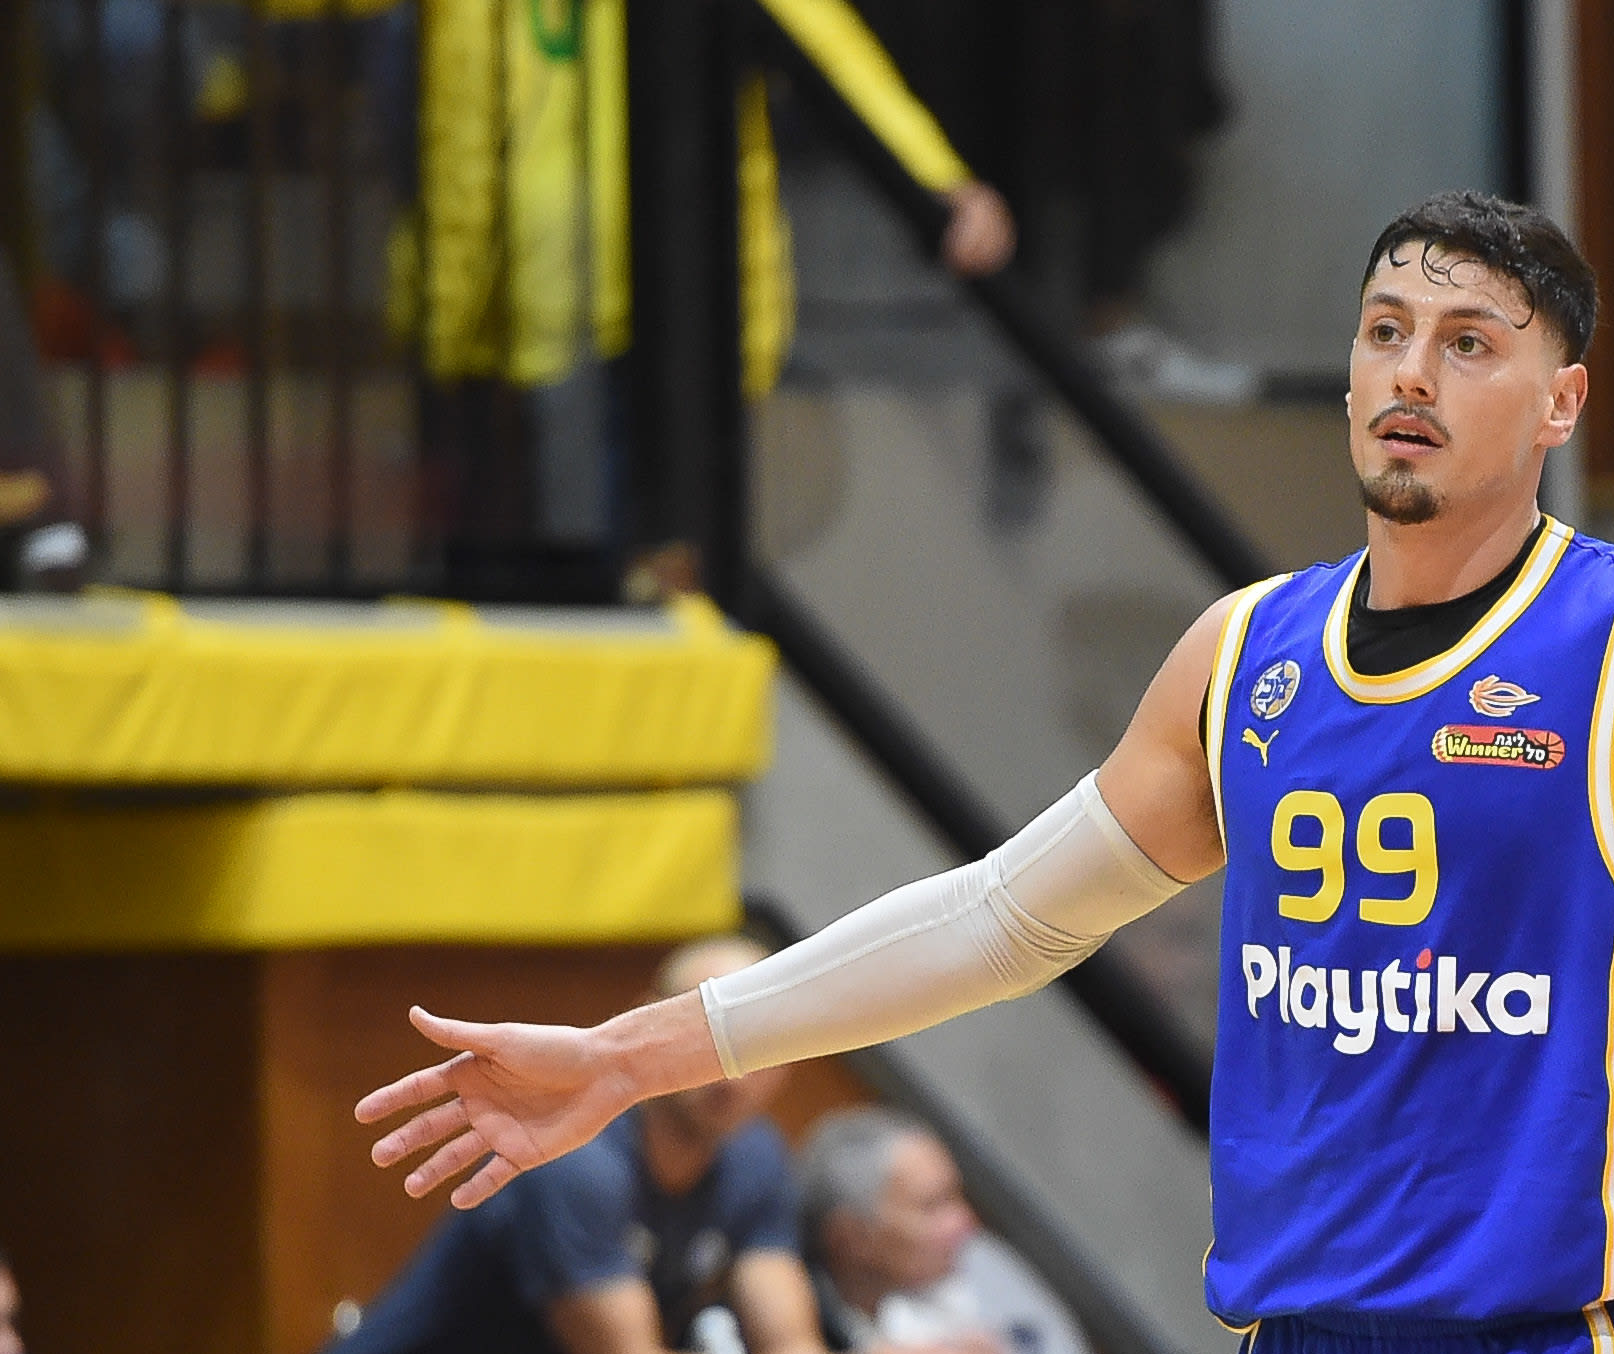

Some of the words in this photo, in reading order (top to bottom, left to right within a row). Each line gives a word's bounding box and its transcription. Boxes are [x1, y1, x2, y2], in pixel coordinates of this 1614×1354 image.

[1446, 734, 1524, 759] Winner
[1495, 732, 1525, 747] ליגת
[1526, 744, 1546, 761] סל
[1271, 790, 1439, 926] 99
[1242, 944, 1551, 1055] Playtika
